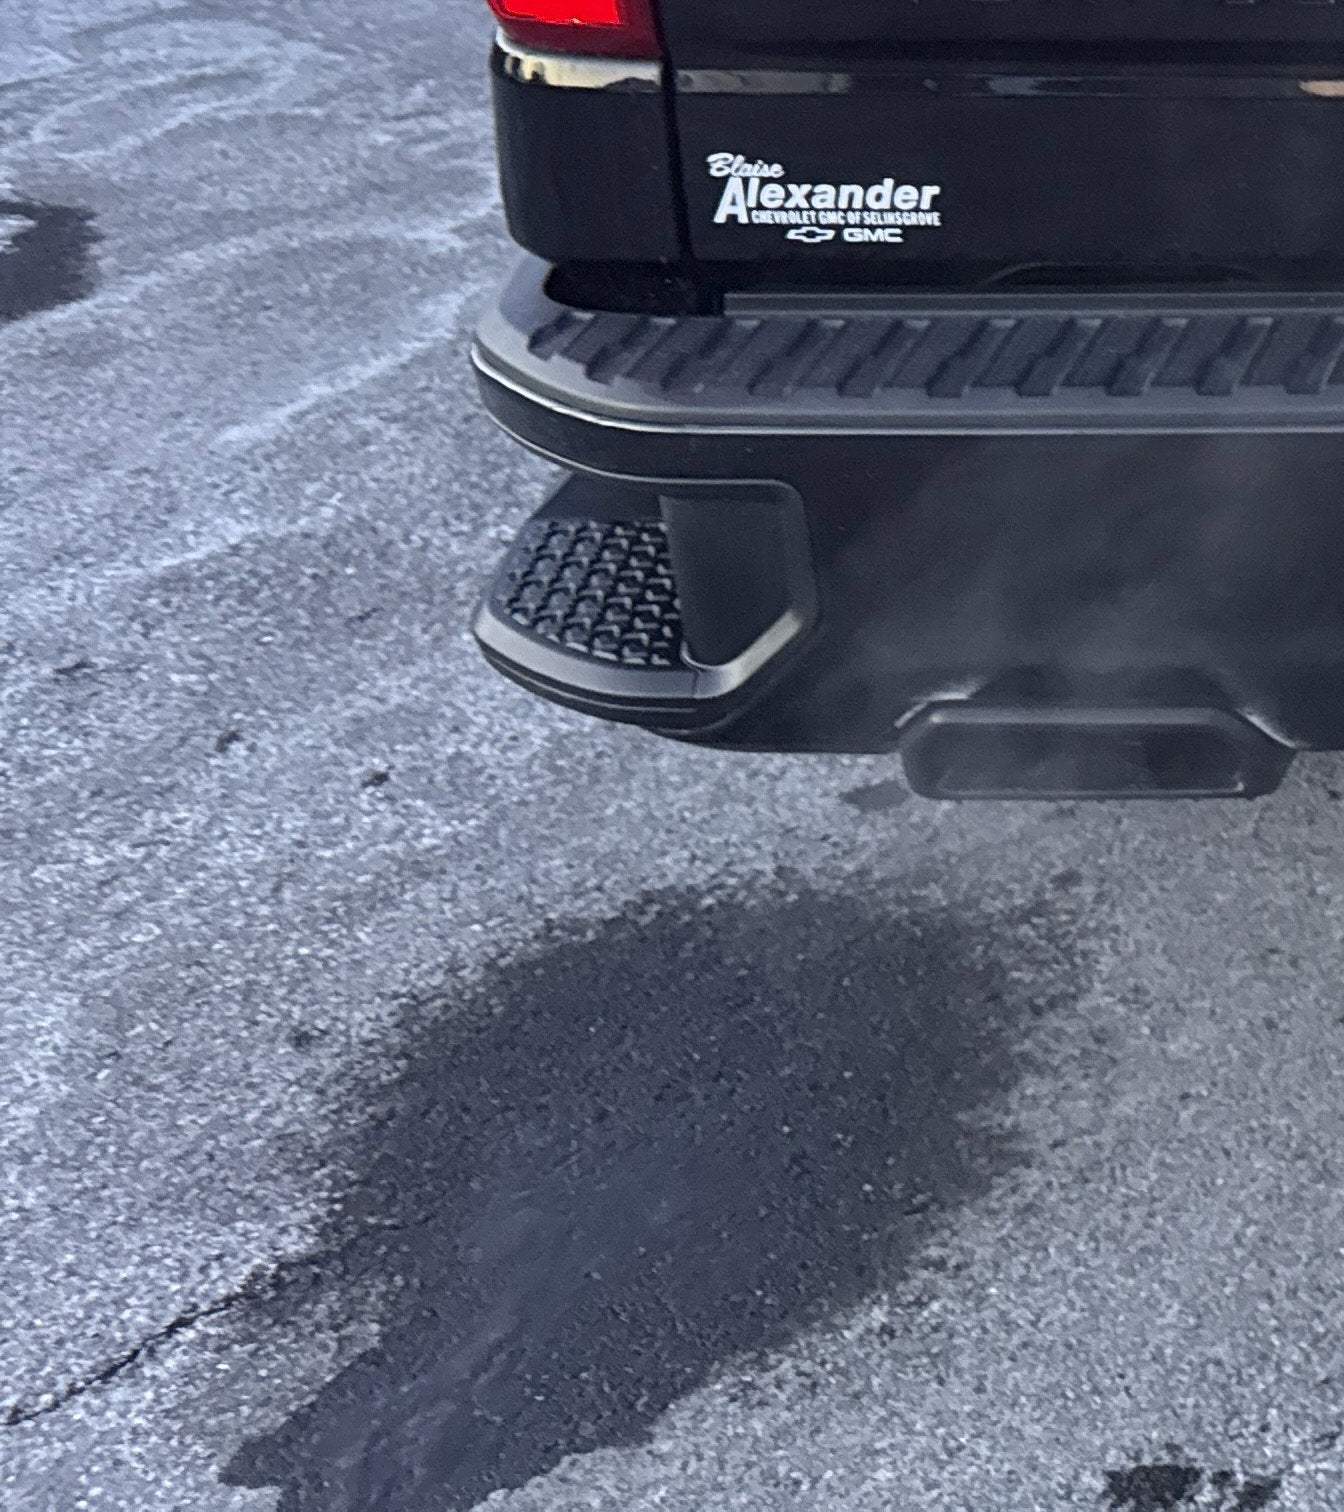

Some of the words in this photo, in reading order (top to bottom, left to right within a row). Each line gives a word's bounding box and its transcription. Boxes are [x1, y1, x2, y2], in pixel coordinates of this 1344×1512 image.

[706, 152, 784, 178] Blaise
[713, 177, 941, 224] Alexander
[751, 209, 816, 225] CHEVROLET
[818, 210, 846, 225] GMC
[847, 211, 862, 225] OF
[863, 211, 942, 226] SELINSGROVE
[842, 228, 903, 243] GMC
